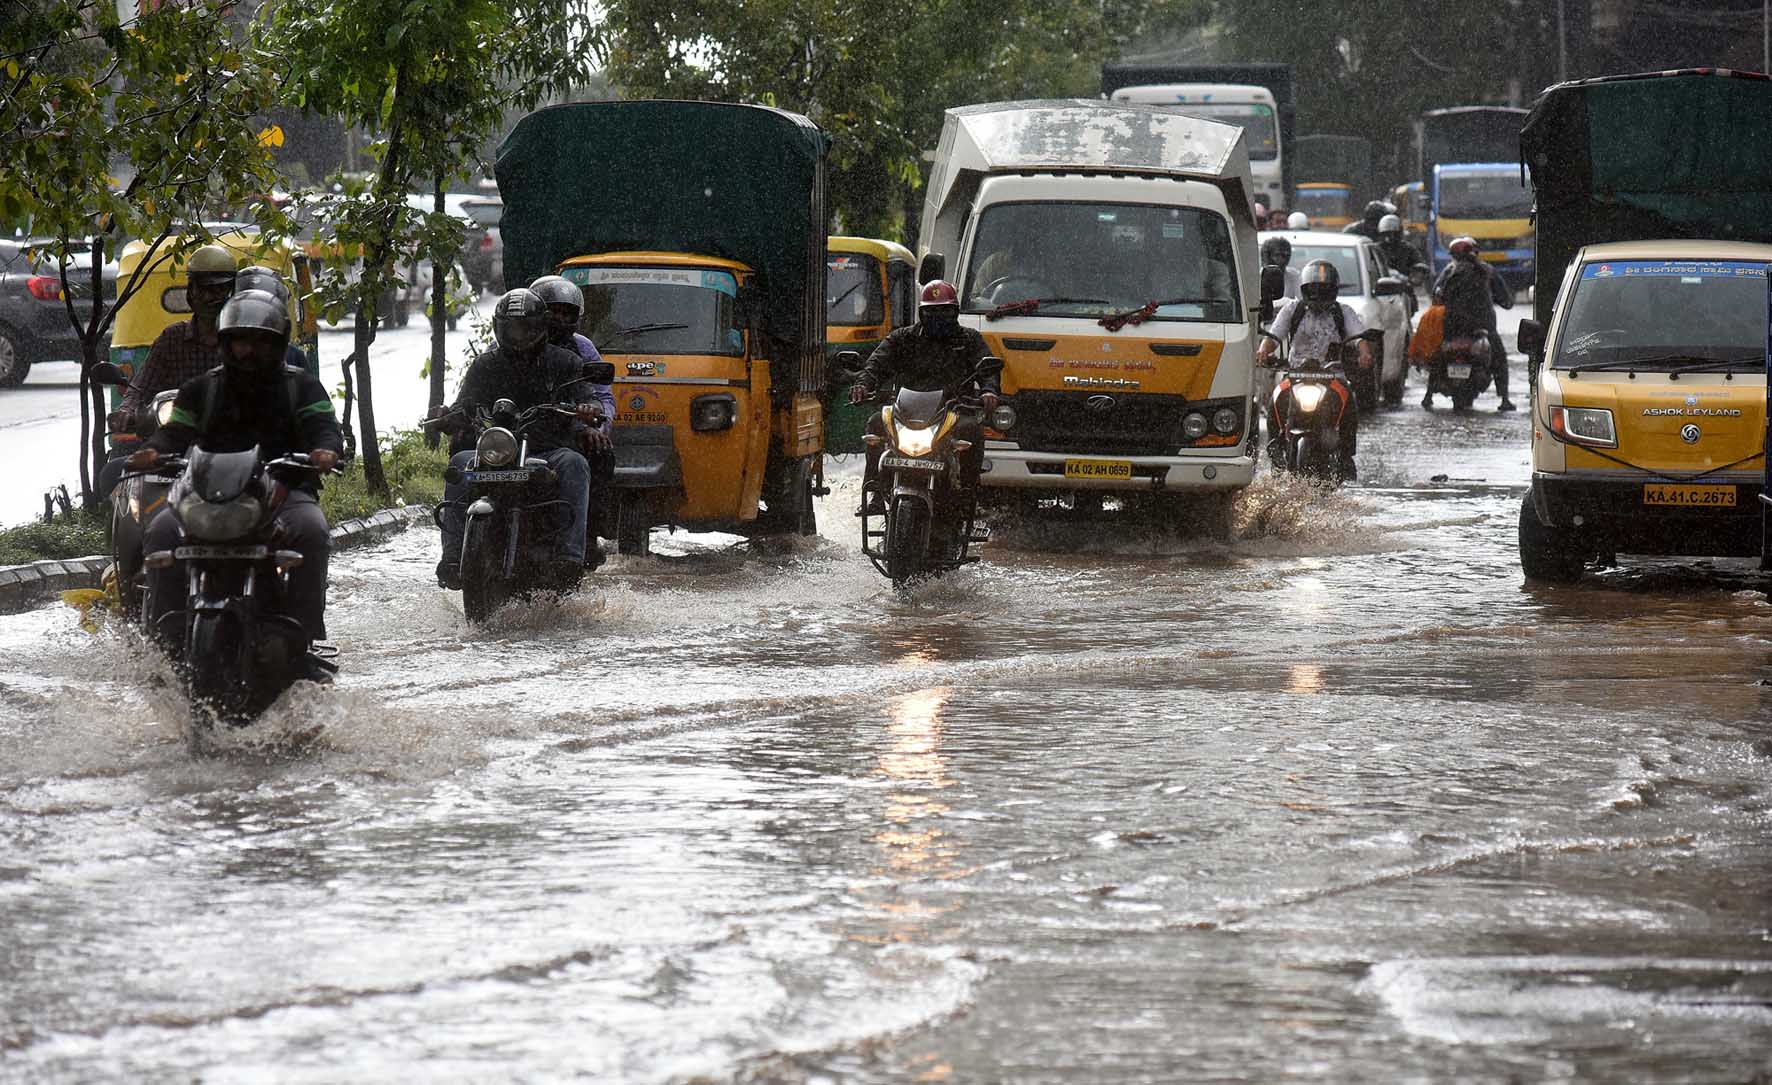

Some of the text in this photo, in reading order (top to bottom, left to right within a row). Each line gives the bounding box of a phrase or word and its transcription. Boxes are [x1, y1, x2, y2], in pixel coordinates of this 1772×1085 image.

[1063, 376, 1140, 388] Mahindra
[1642, 408, 1742, 417] ASHOK LEYLAND
[1067, 463, 1129, 476] KA 02 AH 0659
